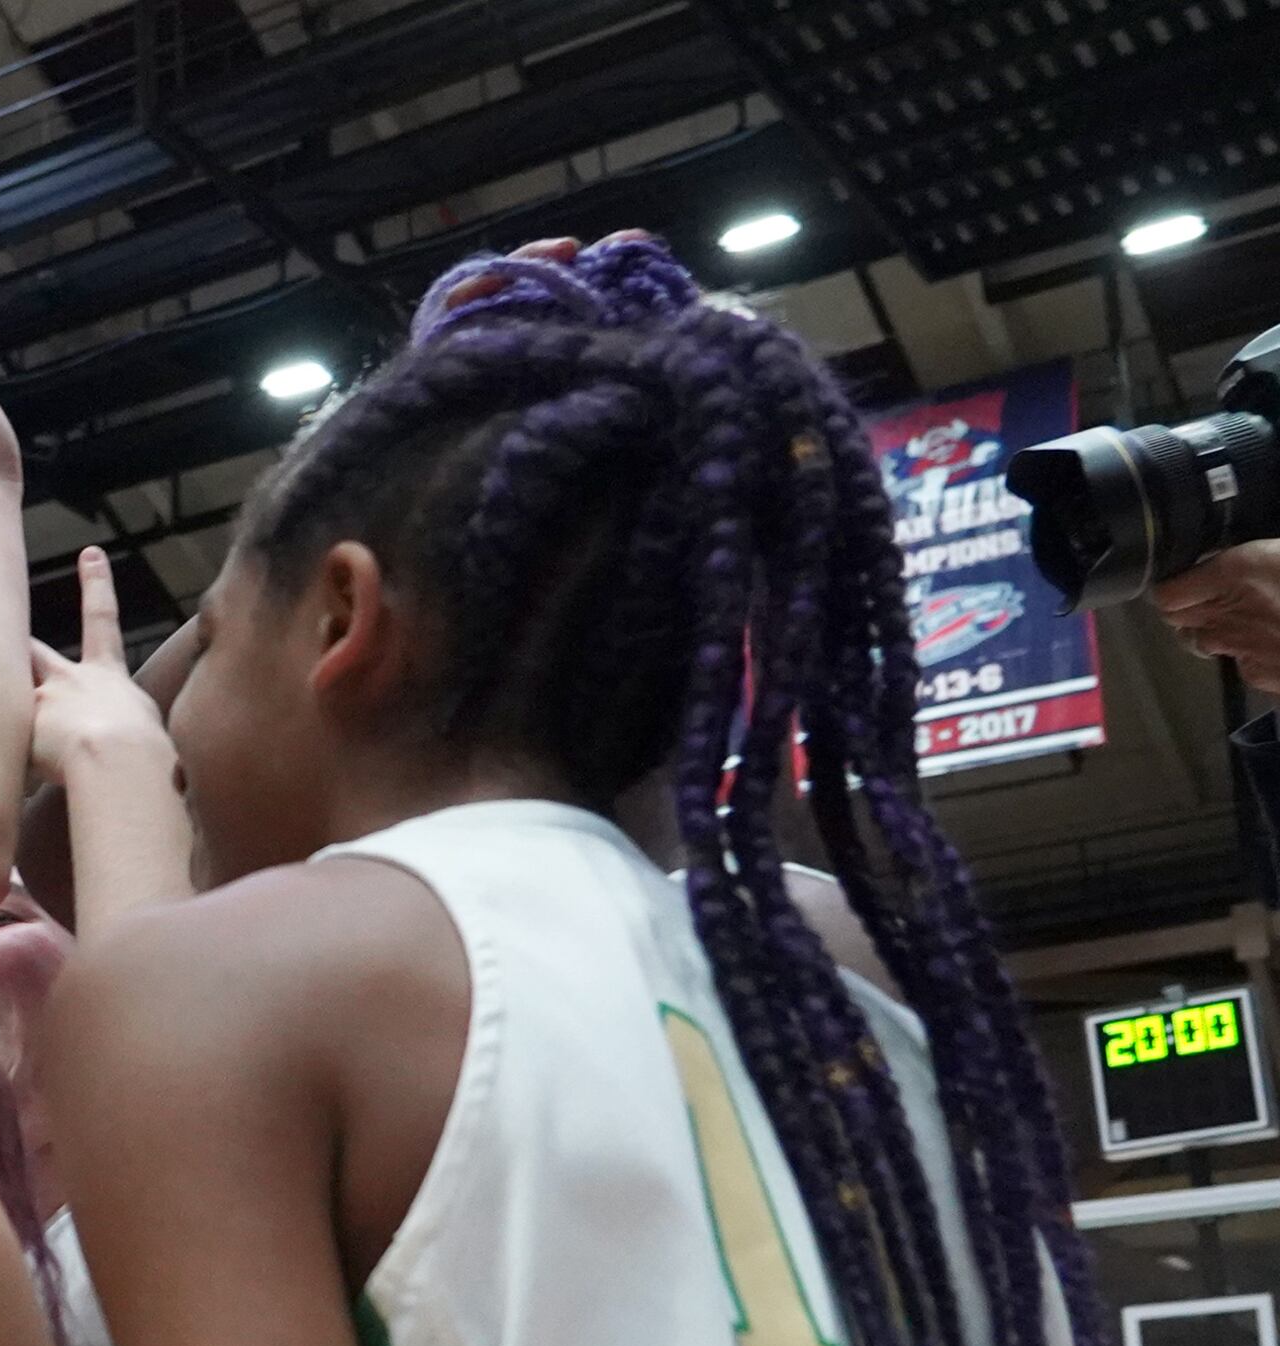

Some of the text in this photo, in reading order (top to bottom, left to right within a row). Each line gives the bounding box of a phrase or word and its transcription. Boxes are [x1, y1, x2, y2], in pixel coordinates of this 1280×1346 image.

[900, 528, 1022, 579] MPIONS
[957, 702, 1037, 746] 2017
[1102, 1001, 1239, 1068] 20:00
